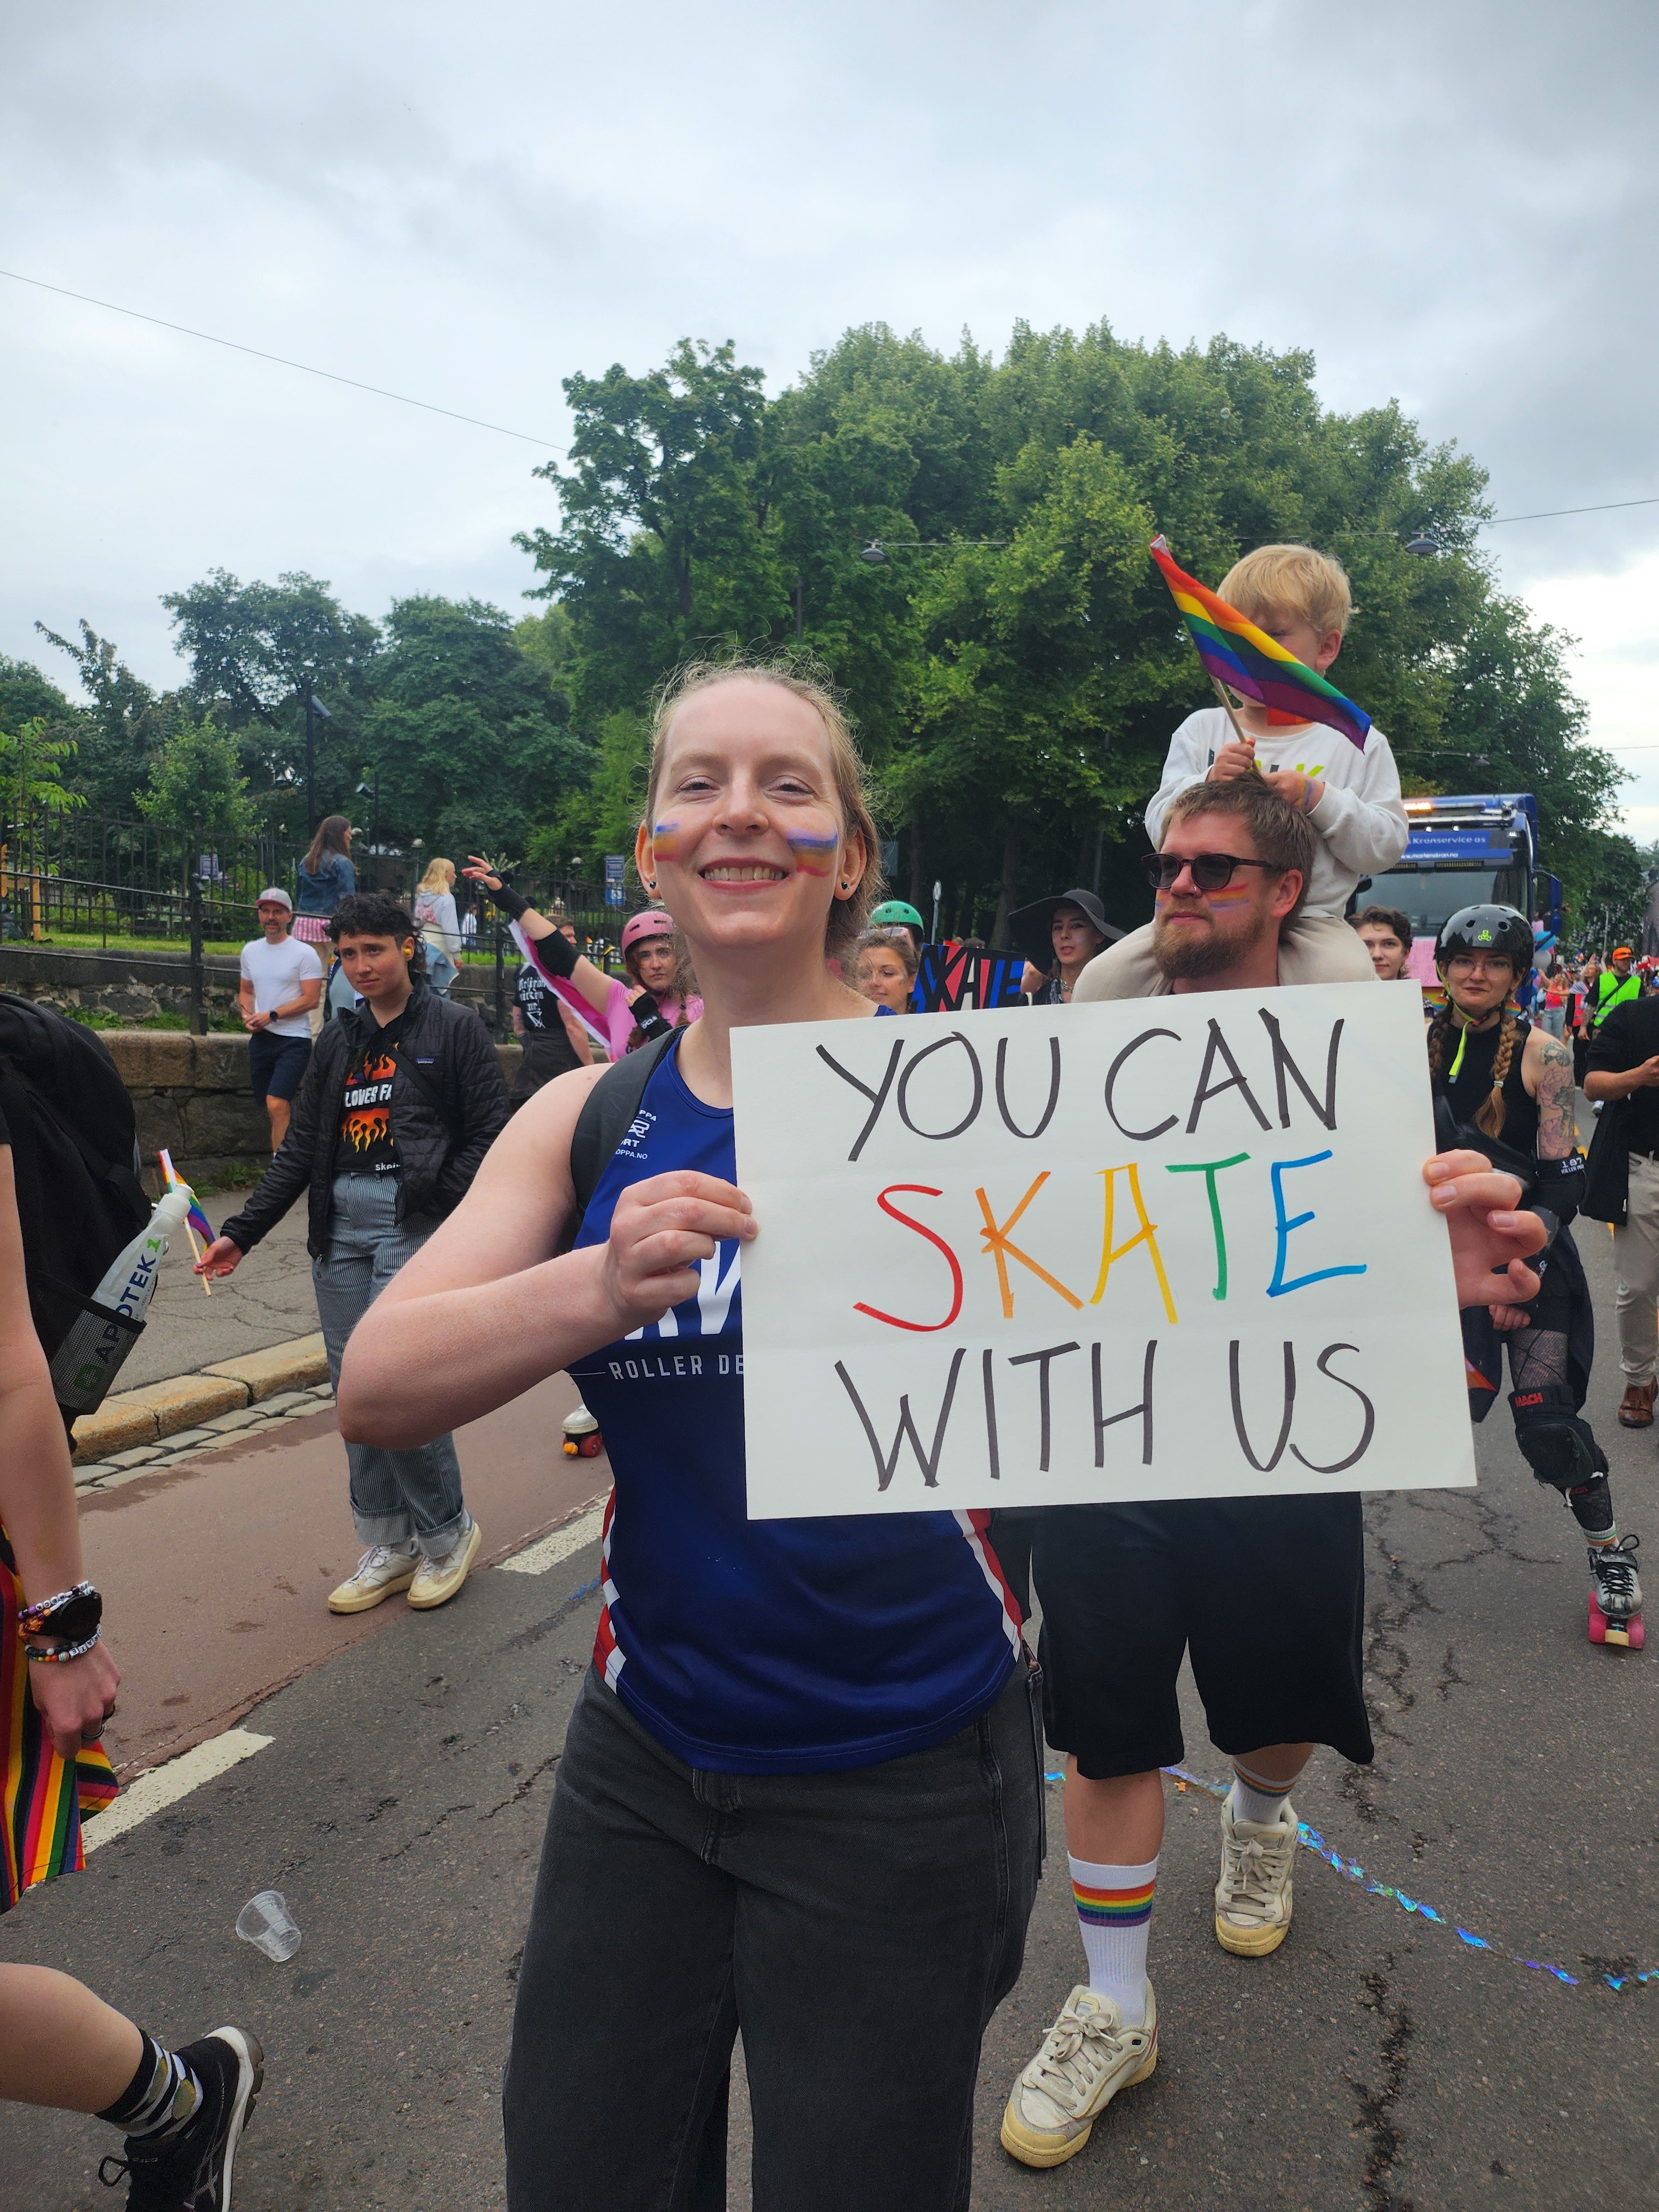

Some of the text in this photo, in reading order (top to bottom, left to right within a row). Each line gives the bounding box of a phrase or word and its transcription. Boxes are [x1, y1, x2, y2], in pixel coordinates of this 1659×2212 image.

[1412, 836, 1472, 844] Kranservice
[910, 943, 1026, 1011] SKATE
[345, 1086, 379, 1108] LOVES
[816, 1008, 1344, 1161] YOU CAN
[1562, 1157, 1582, 1168] 187
[853, 1150, 1367, 1332] SKATE
[608, 1355, 703, 1380] ROLLER
[1515, 1392, 1544, 1408] MACH
[834, 1340, 1374, 1491] WITH US
